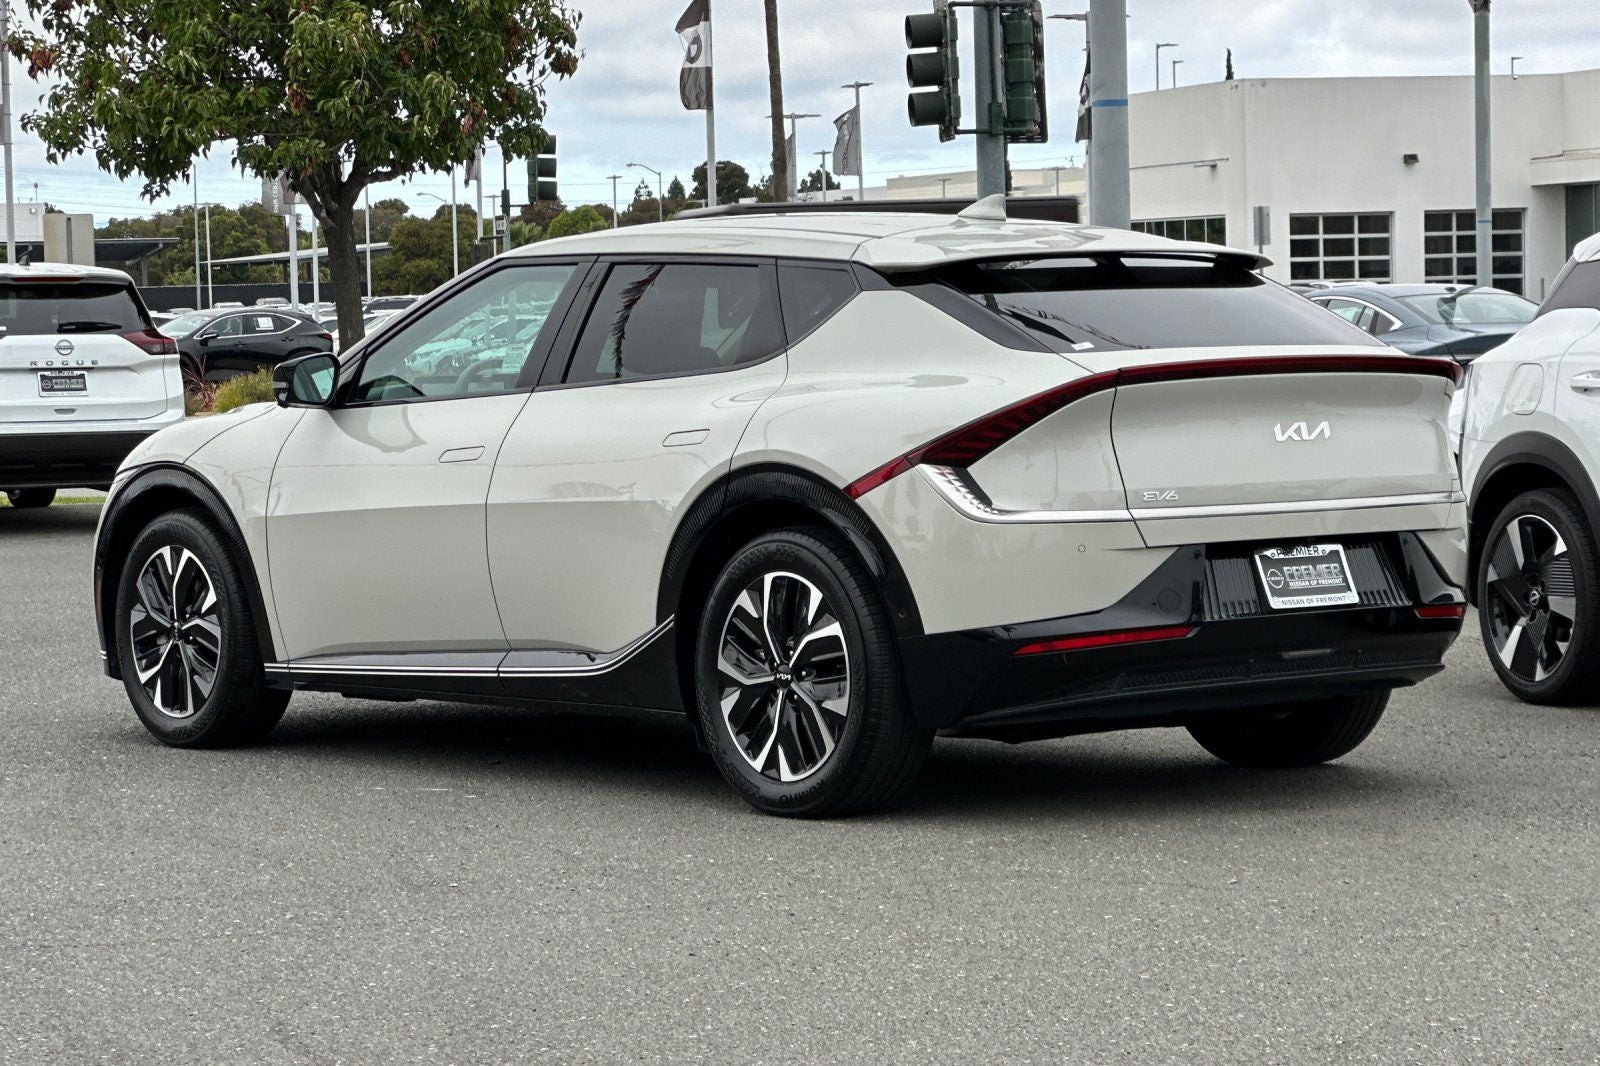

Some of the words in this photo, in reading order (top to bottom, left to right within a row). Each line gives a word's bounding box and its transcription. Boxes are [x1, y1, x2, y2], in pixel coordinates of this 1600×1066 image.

[1274, 421, 1331, 442] KIA
[1143, 490, 1179, 502] EV6
[1283, 564, 1344, 581] PREMIER
[1289, 580, 1310, 588] NISSAN
[1281, 598, 1305, 606] NISSAN
[1315, 596, 1346, 605] FREMONT
